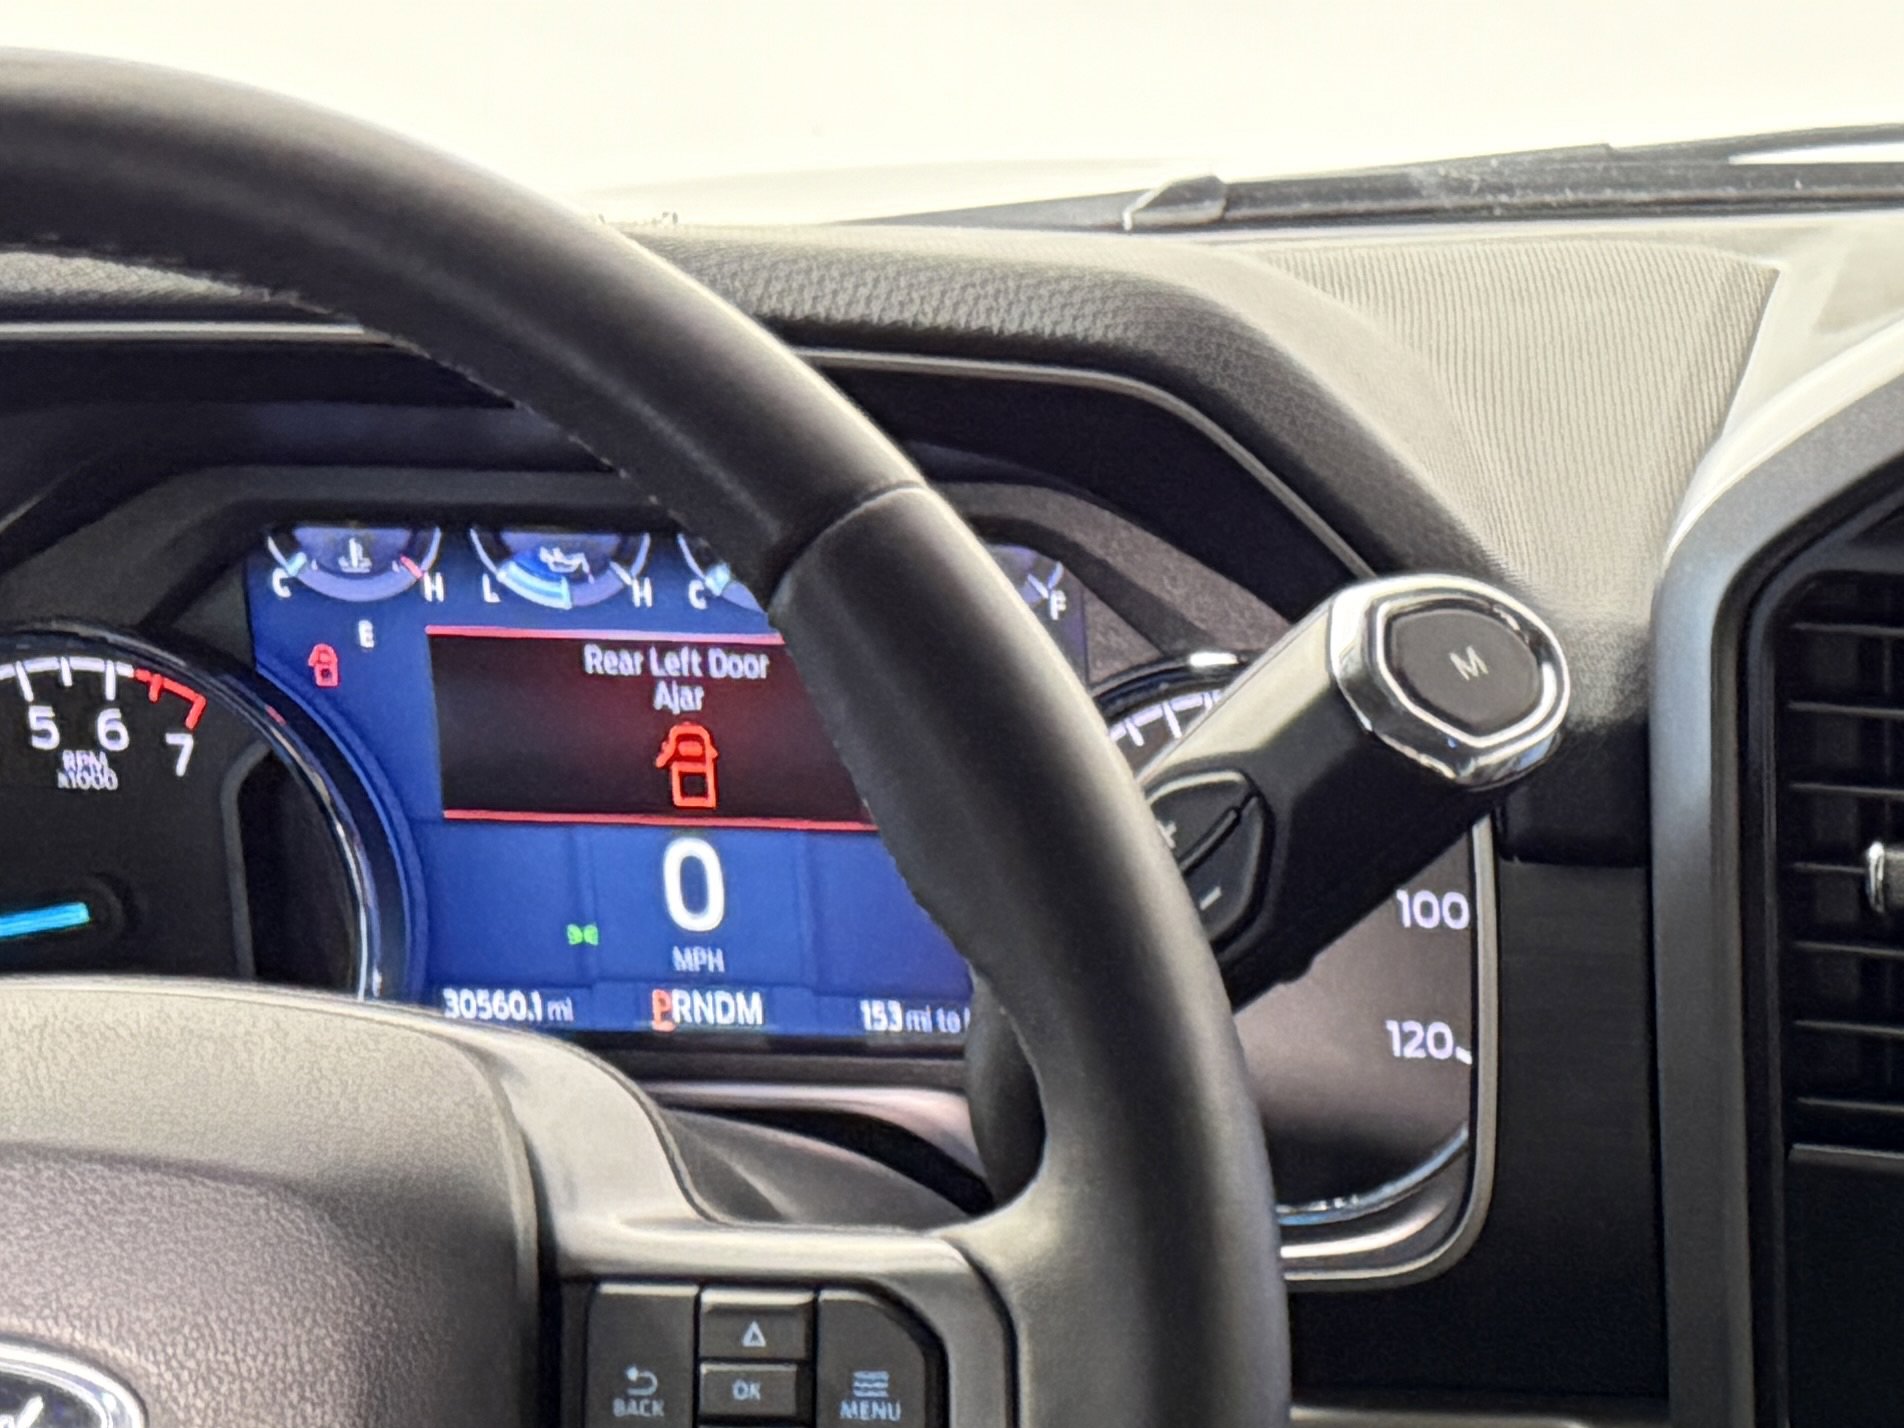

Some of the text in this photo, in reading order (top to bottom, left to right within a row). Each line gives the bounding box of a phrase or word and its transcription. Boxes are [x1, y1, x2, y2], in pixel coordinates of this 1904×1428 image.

[423, 573, 444, 602] H
[483, 574, 500, 603] L
[633, 577, 653, 608] H
[1049, 590, 1067, 621] F
[357, 619, 375, 649] E
[583, 644, 769, 681] Rear Left Door
[1450, 646, 1488, 681] M
[653, 682, 705, 713] Ajar
[28, 705, 60, 750] 5
[97, 708, 130, 752] 6
[165, 732, 194, 777] 7
[662, 836, 726, 933] 0
[1396, 888, 1470, 932] 100
[671, 945, 726, 974] MPH
[441, 987, 575, 1023] 30560.1 mi
[651, 988, 765, 1032] PRNDM
[936, 1006, 962, 1035] to
[1386, 1021, 1455, 1061] 120
[732, 1379, 762, 1402] OK
[612, 1397, 665, 1420] BACK
[839, 1400, 902, 1423] MENU
